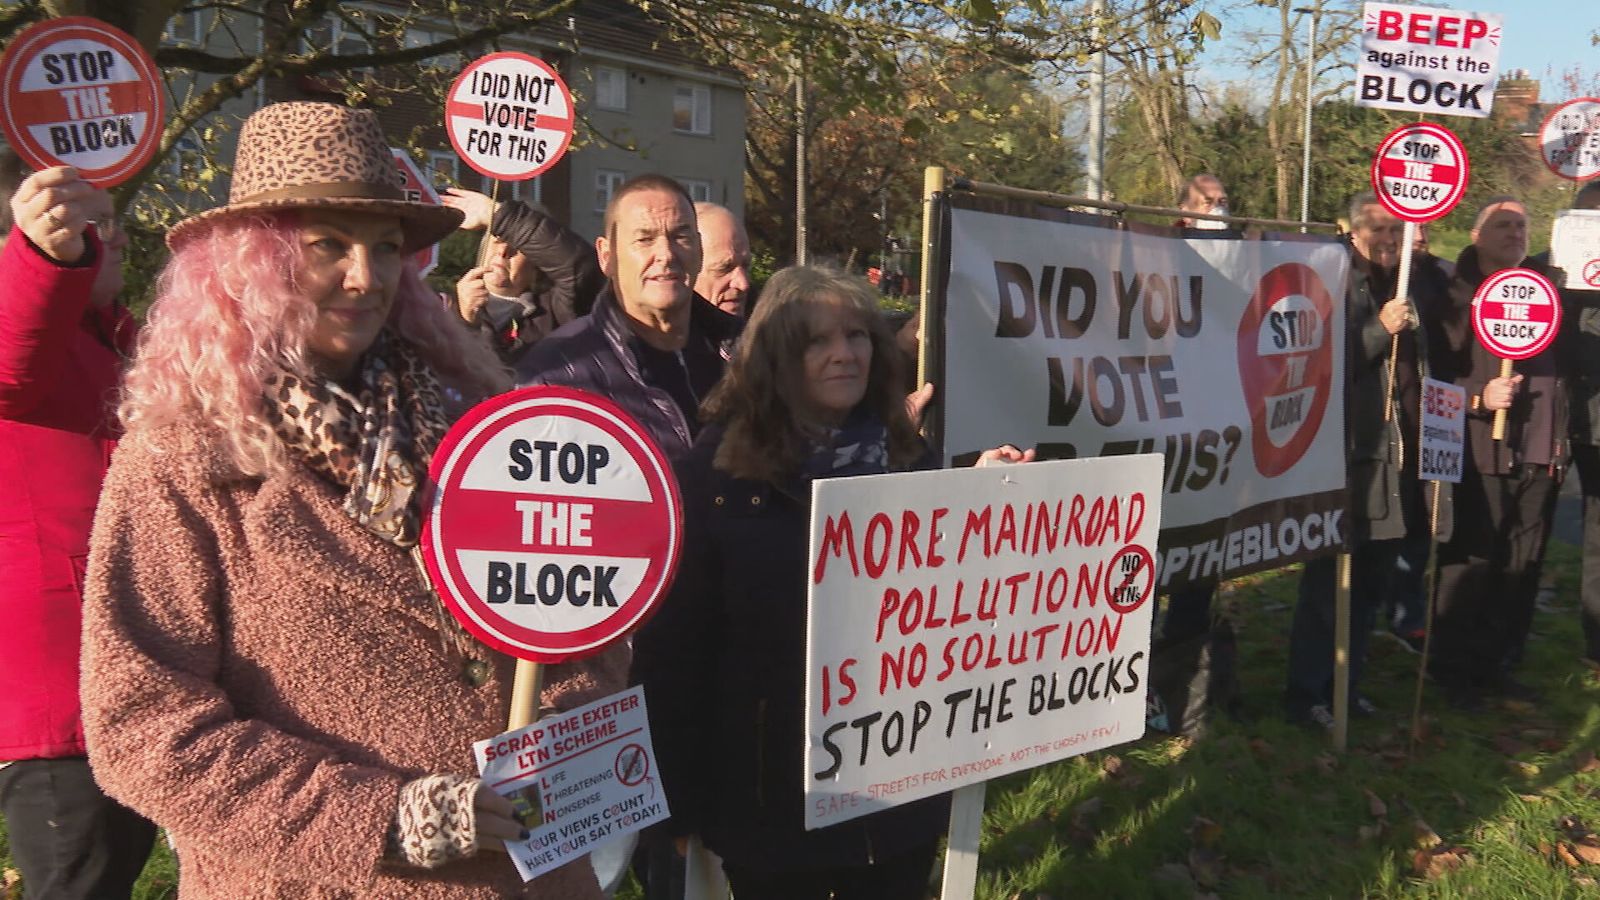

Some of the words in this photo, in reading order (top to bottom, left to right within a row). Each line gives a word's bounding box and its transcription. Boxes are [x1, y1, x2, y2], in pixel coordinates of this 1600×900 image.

[1377, 10, 1488, 49] BEEP
[42, 51, 115, 85] STOP
[1367, 49, 1448, 71] against
[1456, 56, 1490, 74] the
[60, 86, 115, 120] THE
[471, 71, 478, 95] I
[480, 72, 510, 99] DID
[514, 73, 555, 105] NOT
[1361, 75, 1487, 110] BLOCK
[51, 116, 136, 155] BLOCK
[485, 101, 537, 132] VOTE
[466, 128, 502, 156] FOR
[508, 134, 547, 164] THIS
[1403, 141, 1440, 159] STOP
[1404, 161, 1434, 181] THE
[1392, 182, 1440, 202] BLOCK
[994, 261, 1097, 340] DID
[1112, 271, 1203, 340] YOU
[1502, 285, 1536, 299] STOP
[1270, 309, 1317, 350] STOP
[1493, 324, 1536, 339] BLOCK
[1503, 304, 1529, 320] THE
[1046, 355, 1184, 428] VOTE
[508, 439, 609, 485] STOP
[1422, 447, 1460, 476] BLOCK
[515, 500, 593, 547] THE
[814, 507, 949, 586] MORE
[1121, 555, 1141, 572] NO
[486, 561, 620, 607] BLOCK
[875, 560, 1103, 643] POLLUTION
[822, 658, 858, 717] IS
[879, 642, 928, 696] NO
[936, 613, 1123, 682] SOLUTION
[484, 729, 544, 763] SCRAP
[547, 716, 580, 740] THE
[582, 694, 640, 727] EXETER
[814, 701, 933, 780] STOP
[944, 678, 1017, 739] THE
[1028, 651, 1144, 716] BLOCKS
[517, 746, 550, 770] LTN
[554, 720, 618, 757] SCHEME
[815, 790, 860, 818] SAFE
[866, 774, 921, 801] STREETS
[922, 768, 948, 786] FOR
[950, 753, 1006, 779] EVERYONE
[1009, 746, 1032, 762] NOT
[1033, 742, 1052, 756] THE
[1052, 732, 1089, 751] CHOSEN
[524, 851, 555, 871] HAVE
[554, 838, 588, 858] YOUR
[590, 820, 617, 842] SAY
[615, 803, 662, 828] TODAY!
[525, 832, 559, 853] YOUR
[560, 815, 600, 840] VIEWS
[602, 793, 646, 820] COUNT
